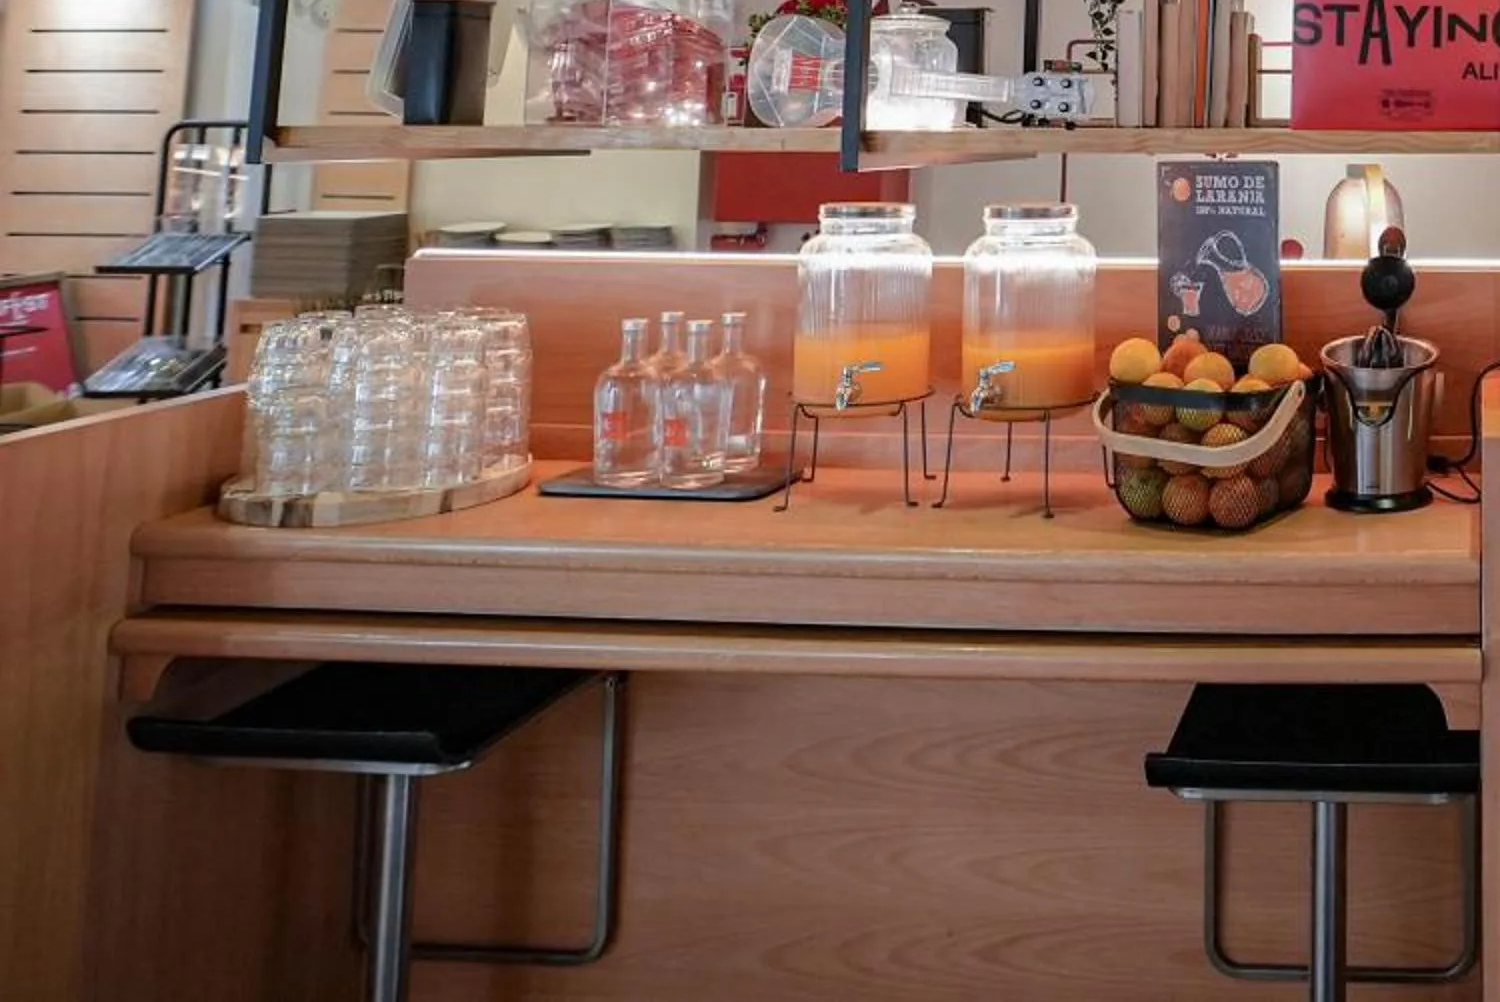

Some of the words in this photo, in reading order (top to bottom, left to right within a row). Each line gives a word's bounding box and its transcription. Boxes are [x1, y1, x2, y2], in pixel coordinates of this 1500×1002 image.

[1195, 176, 1239, 189] SUMO
[1243, 176, 1265, 189] DE
[1218, 205, 1266, 217] NATURAL
